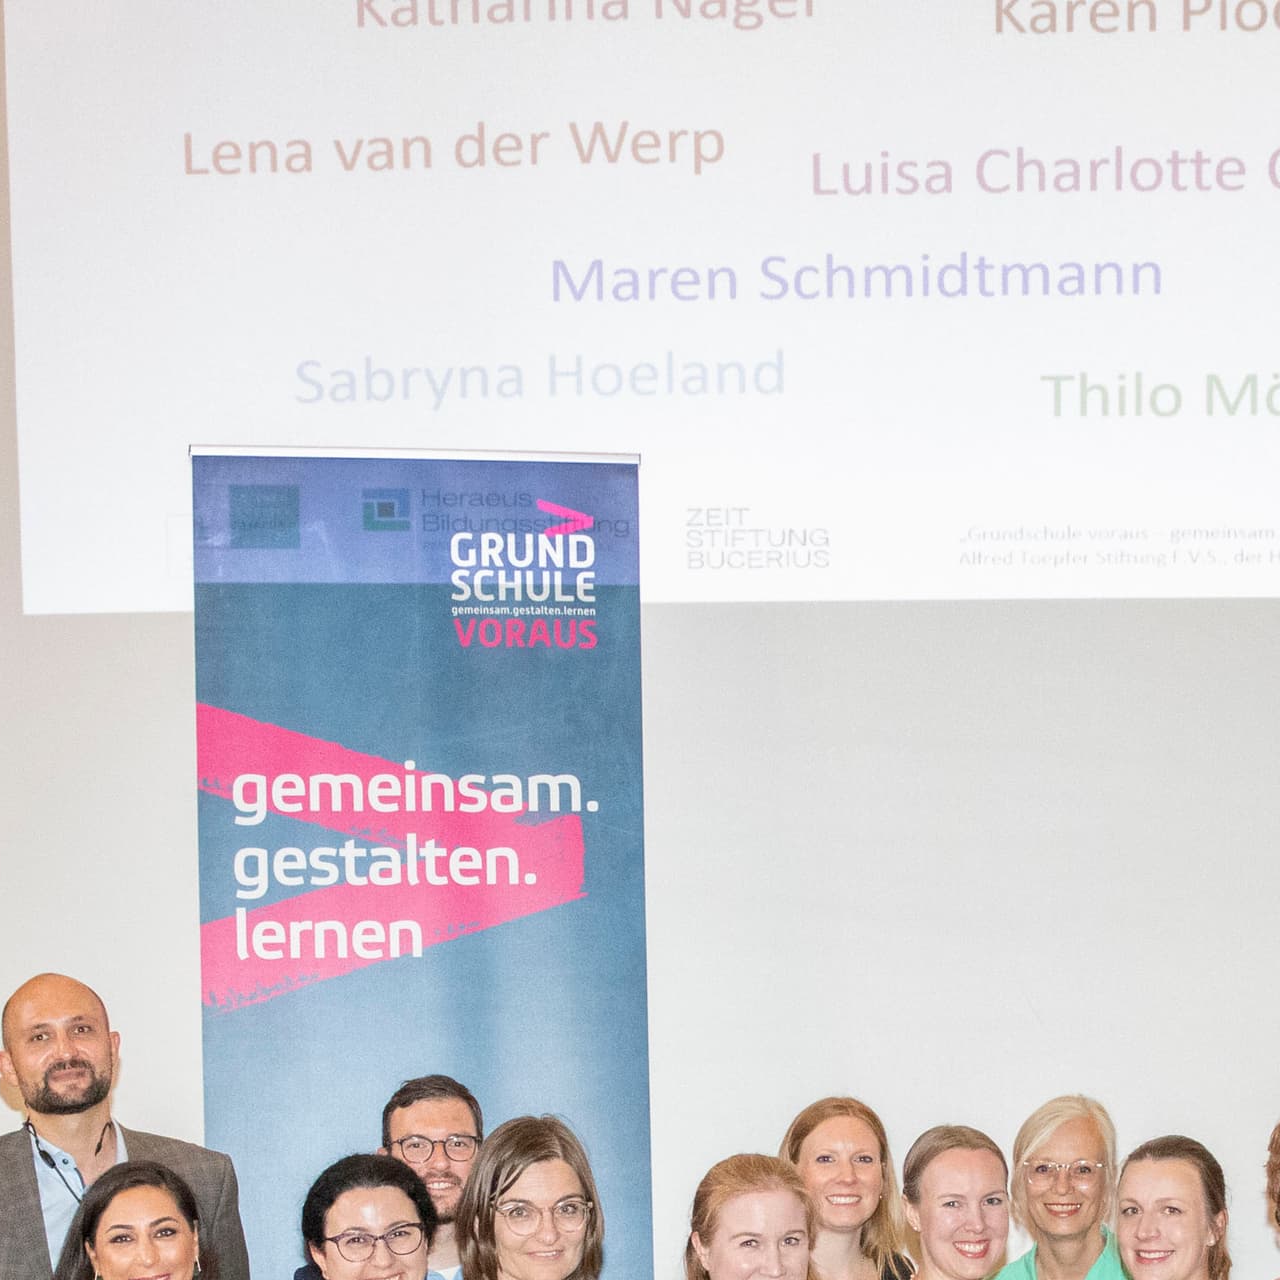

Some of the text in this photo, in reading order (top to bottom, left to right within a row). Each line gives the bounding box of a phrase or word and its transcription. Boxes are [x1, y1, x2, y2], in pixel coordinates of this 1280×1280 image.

[993, 0, 1158, 35] Karen
[182, 119, 726, 177] Lena van der Werp
[811, 149, 954, 197] Luisa
[975, 144, 1247, 195] Charlotte
[551, 250, 1162, 303] Maren Schmidtmann
[295, 349, 785, 411] Sabryna Hoeland
[1039, 370, 1183, 418] Thilo
[685, 507, 751, 527] ZEIT
[685, 527, 831, 548] STIFTUNG
[450, 531, 596, 569] GRUND
[686, 549, 831, 570] BUCERIUS
[451, 569, 596, 602] SCHULE
[451, 604, 597, 617] gemeinsam.gestalten.lernen
[452, 617, 599, 650] VORAUS
[232, 760, 599, 826] gemeinsam.
[233, 833, 538, 899] gestalten.
[236, 907, 423, 960] lernen
